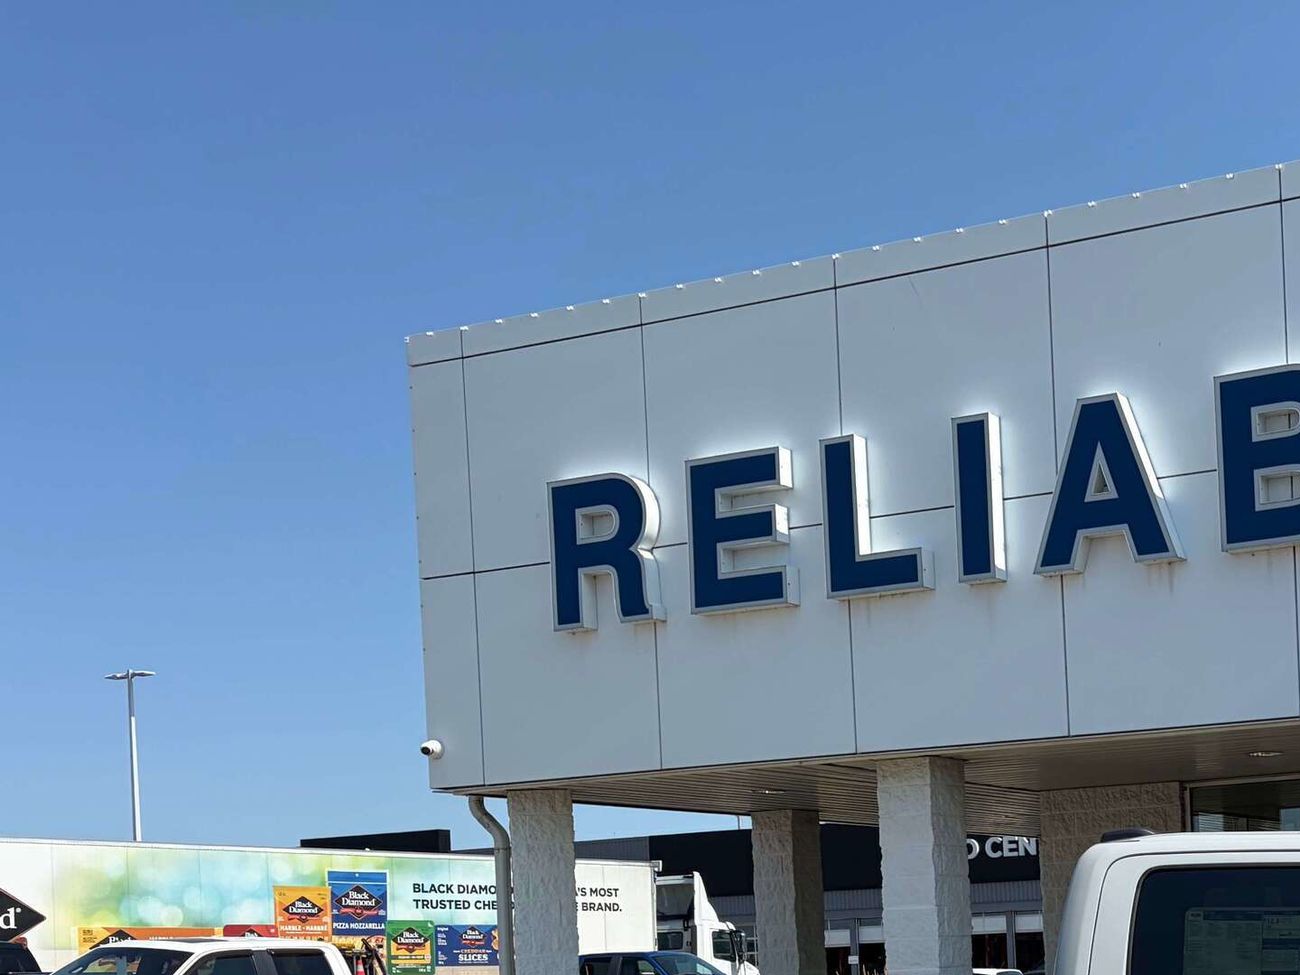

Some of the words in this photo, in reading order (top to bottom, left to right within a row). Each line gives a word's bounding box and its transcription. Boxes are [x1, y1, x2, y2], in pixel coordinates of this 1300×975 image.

[348, 891, 370, 899] Black
[412, 883, 454, 894] BLACK
[457, 884, 514, 896] DIAMO
[590, 887, 620, 898] MOST
[341, 897, 376, 906] Diamond
[414, 899, 471, 910] TRUSTED
[581, 902, 622, 912] BRAND.
[289, 906, 318, 914] Diamond
[397, 936, 425, 944] Diamond
[458, 953, 489, 962] SLICES
